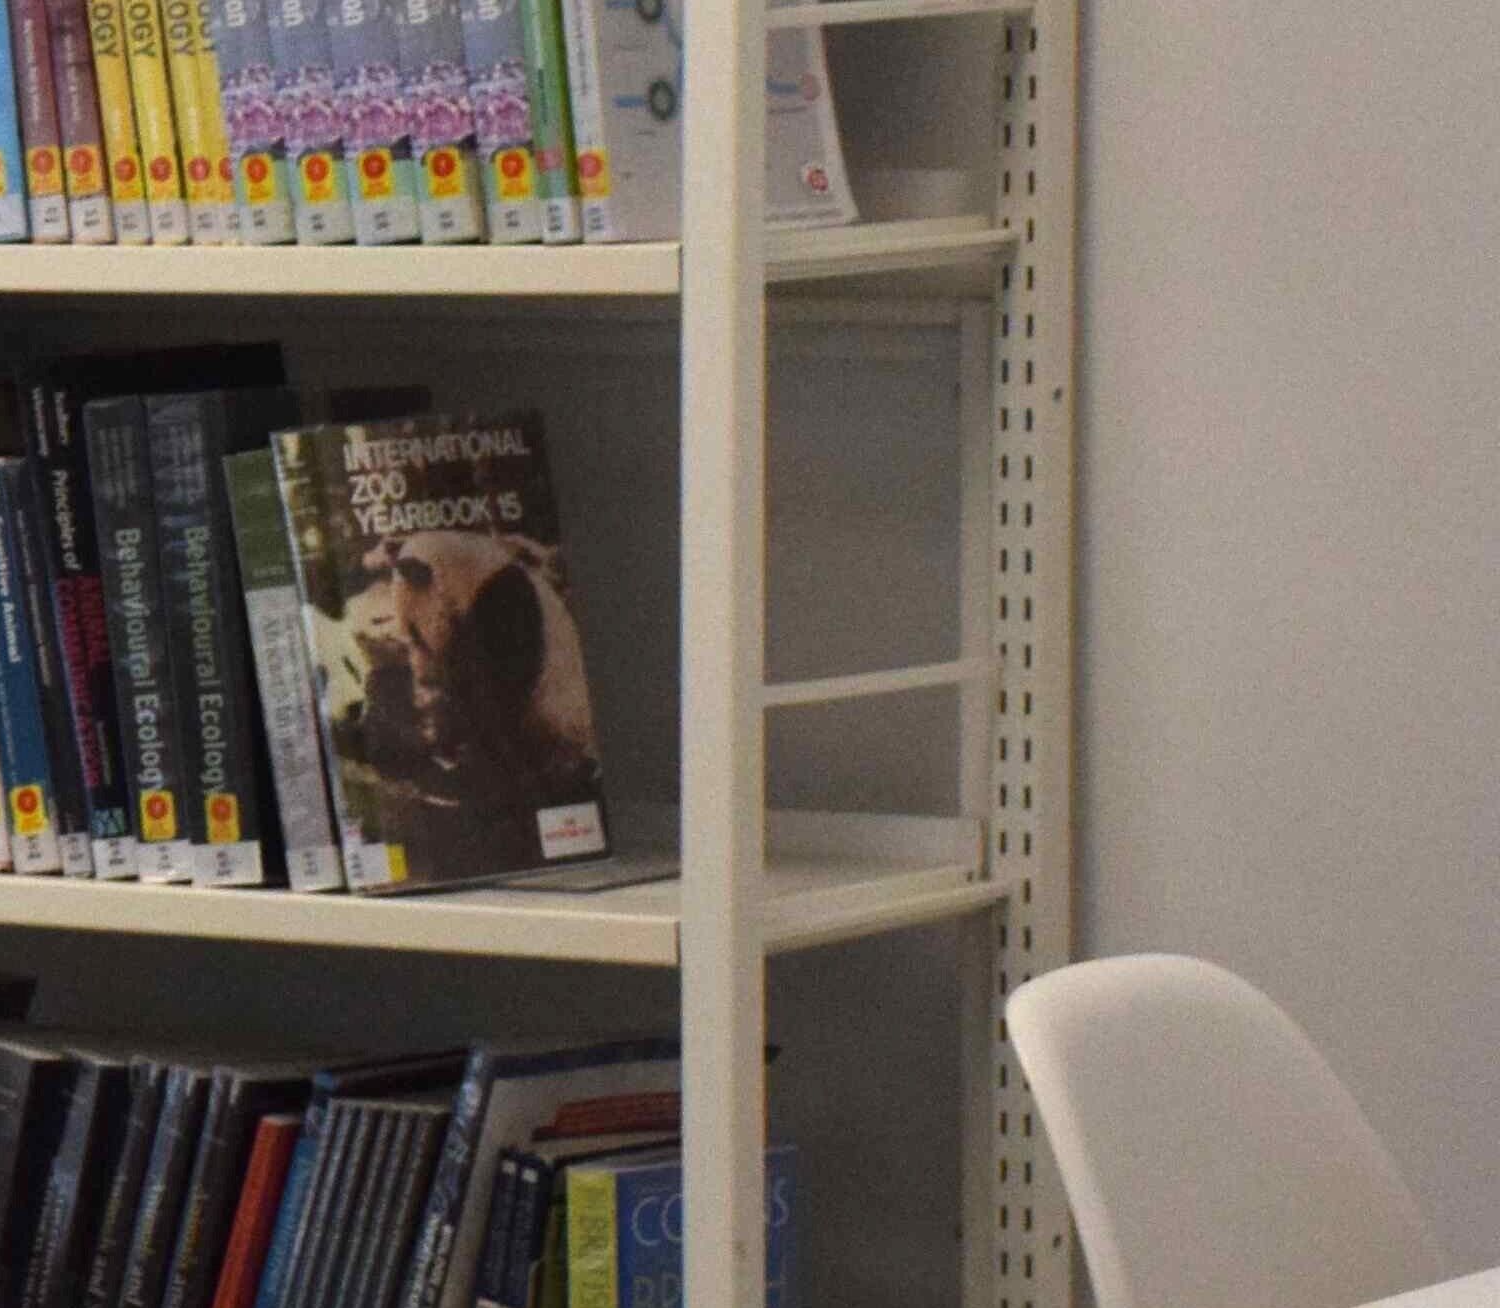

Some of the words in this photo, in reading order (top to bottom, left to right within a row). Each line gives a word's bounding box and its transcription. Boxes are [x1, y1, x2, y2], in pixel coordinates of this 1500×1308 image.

[344, 428, 531, 471] INTERNATIONAL
[49, 467, 78, 546] Principles
[349, 472, 408, 506] ZOO
[355, 493, 494, 536] YEARBOOK
[61, 548, 82, 572] of
[114, 527, 156, 687] Behavioural
[183, 526, 221, 687] Behavioural
[134, 693, 165, 791] Ecolog
[85, 1253, 111, 1298] and
